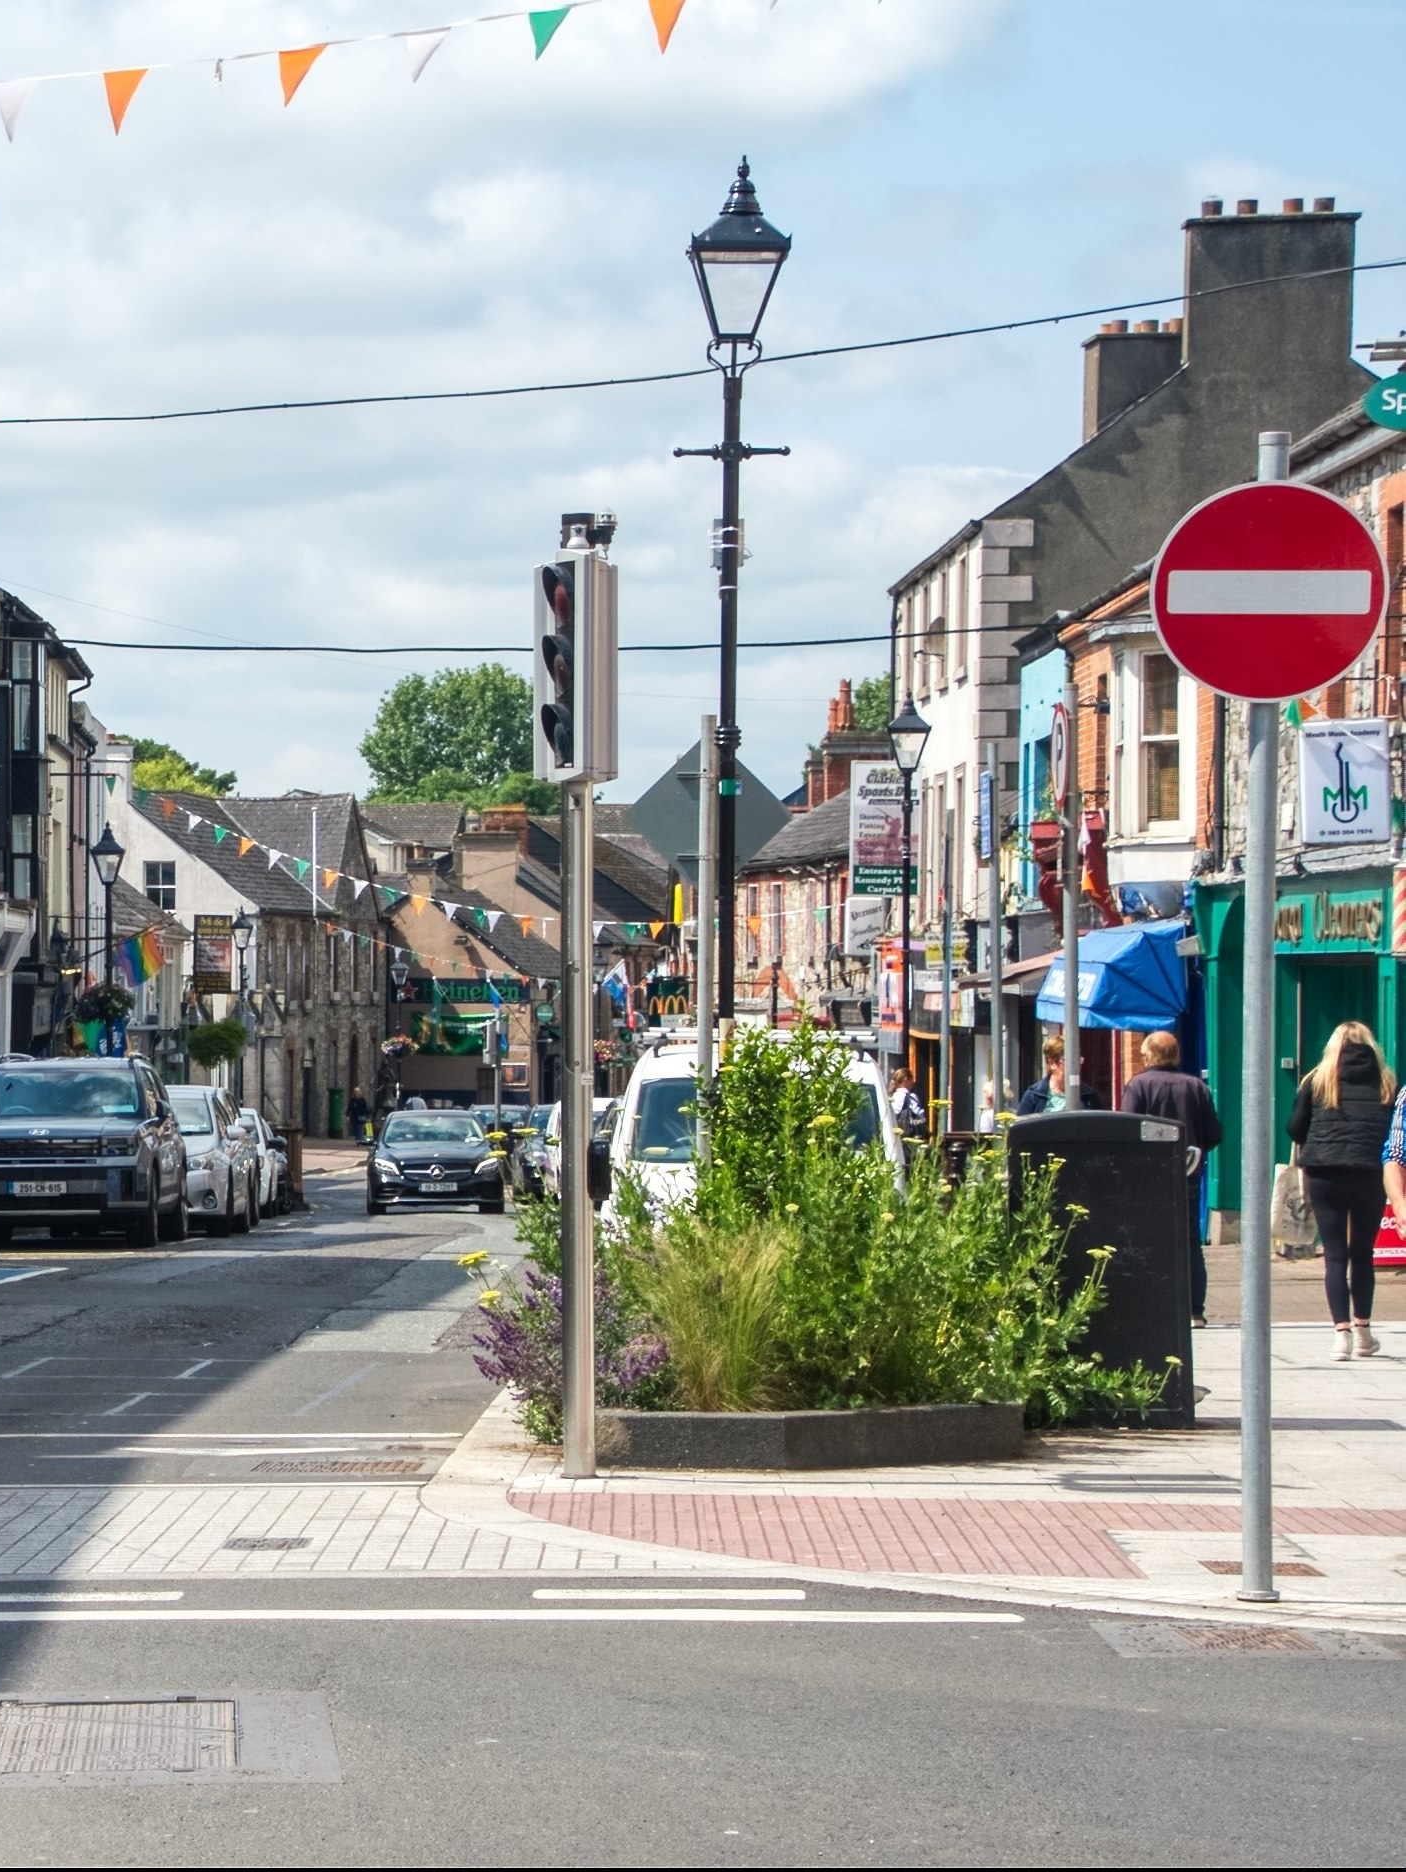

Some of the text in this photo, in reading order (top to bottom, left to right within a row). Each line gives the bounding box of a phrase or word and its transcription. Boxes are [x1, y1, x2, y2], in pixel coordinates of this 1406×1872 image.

[857, 785, 896, 799] Sports
[858, 867, 897, 875] Entrance
[854, 875, 893, 886] Kennedy
[866, 885, 904, 895] Carpark
